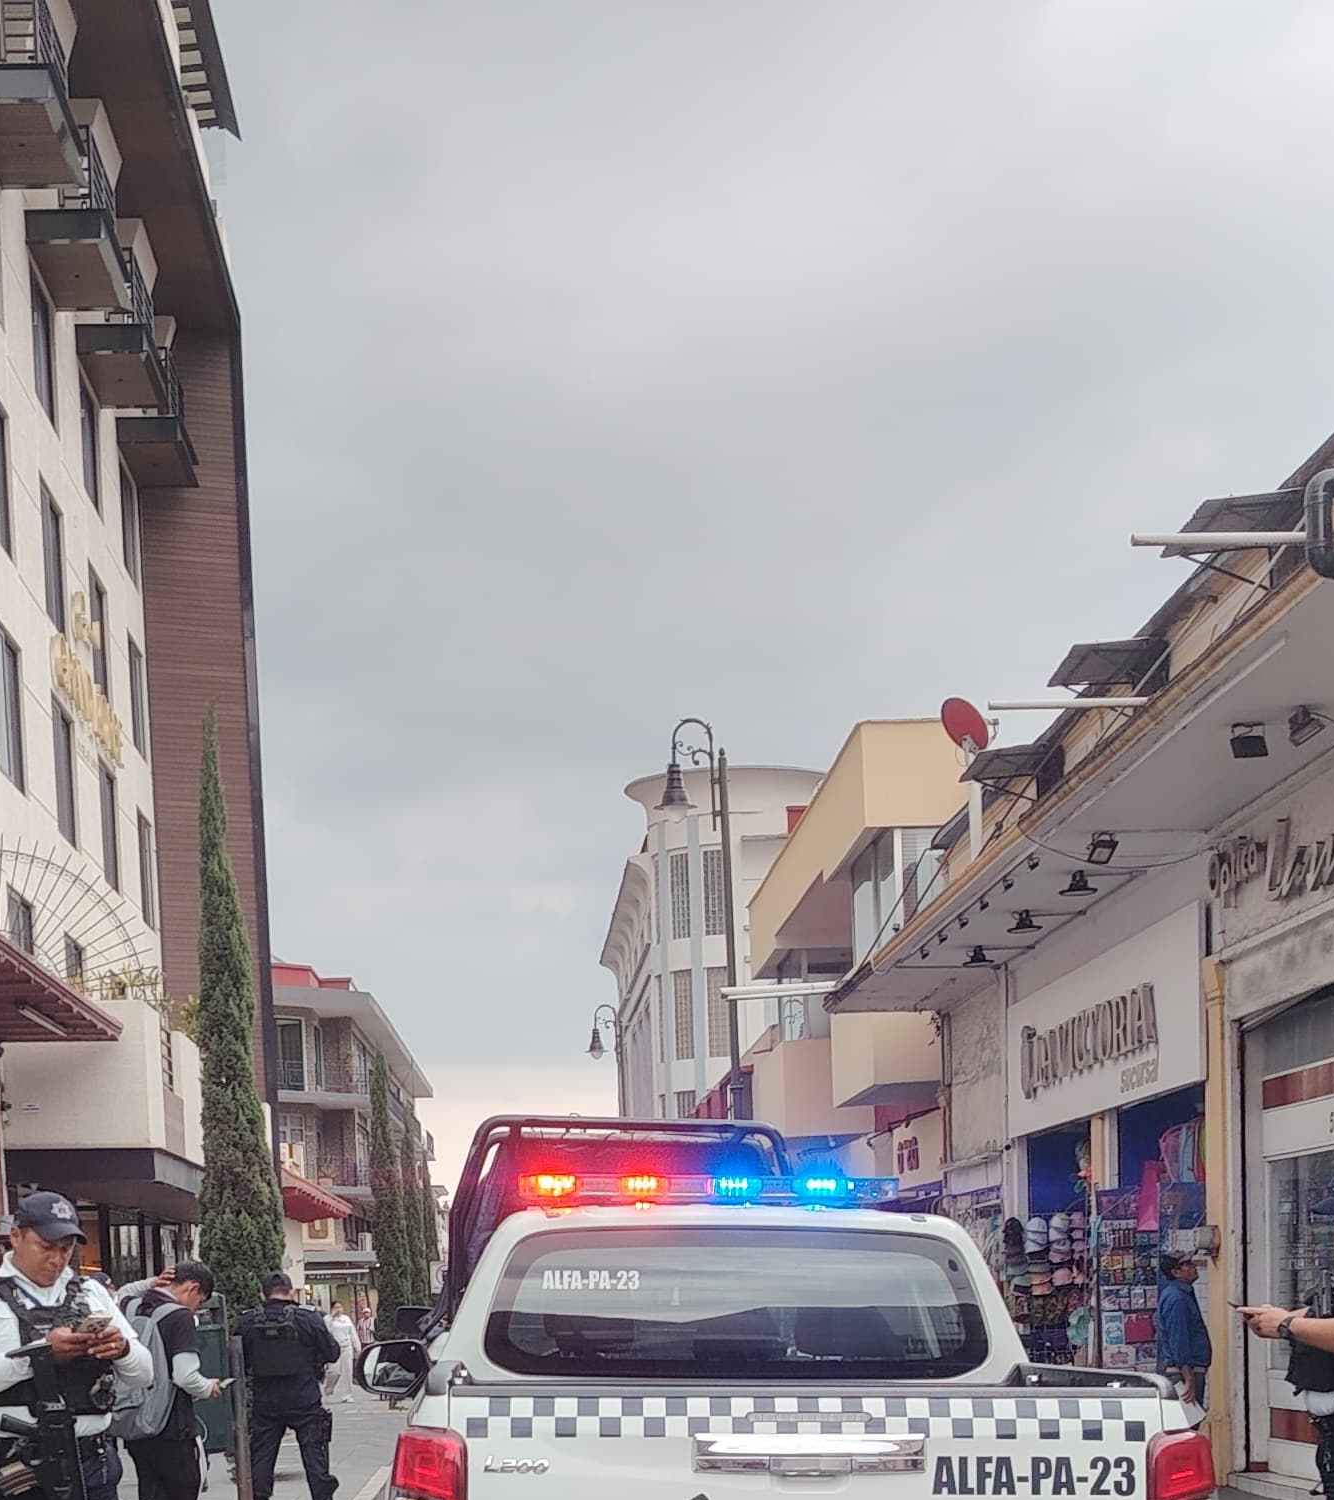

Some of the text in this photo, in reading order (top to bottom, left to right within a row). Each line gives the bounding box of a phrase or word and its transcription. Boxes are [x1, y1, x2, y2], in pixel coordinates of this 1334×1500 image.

[542, 1269, 640, 1290] ALFA-PA-23
[483, 1455, 550, 1475] L200
[932, 1456, 1136, 1497] ALFA-PA-23
